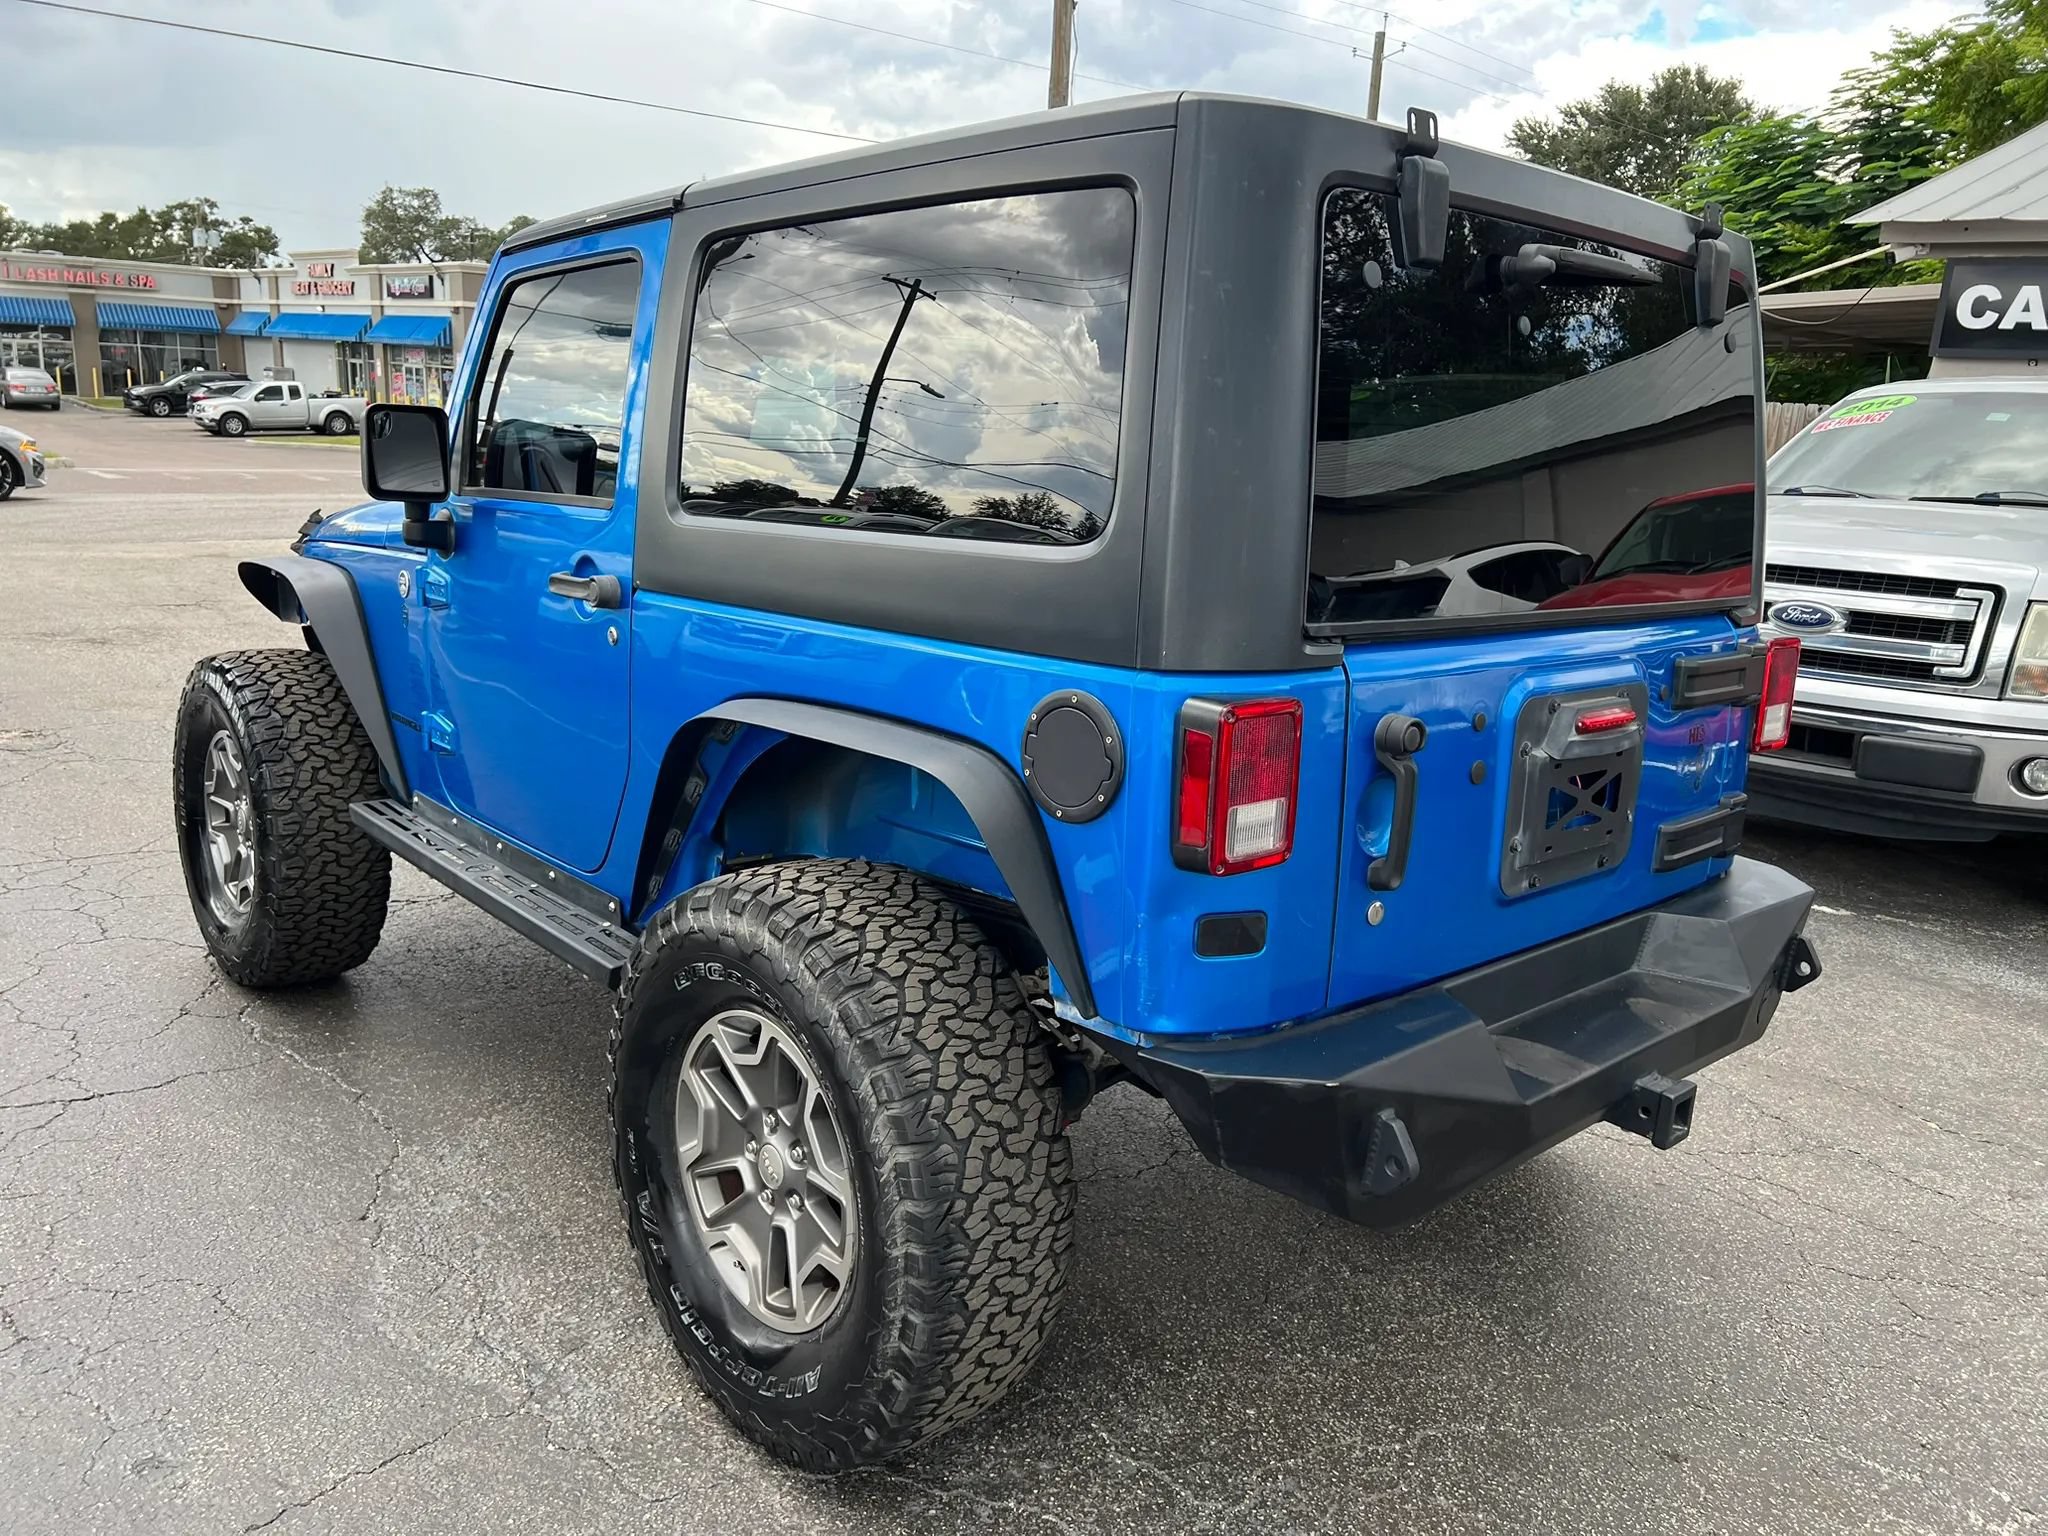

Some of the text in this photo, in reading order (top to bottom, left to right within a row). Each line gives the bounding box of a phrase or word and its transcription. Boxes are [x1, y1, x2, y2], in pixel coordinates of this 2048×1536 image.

[15, 265, 58, 281] LASH
[63, 270, 110, 284] NAILS
[115, 273, 124, 286] &
[129, 274, 156, 288] SPA
[1839, 397, 1906, 415] 2014
[1834, 411, 1889, 426] FINANCE
[1782, 606, 1821, 623] Ford
